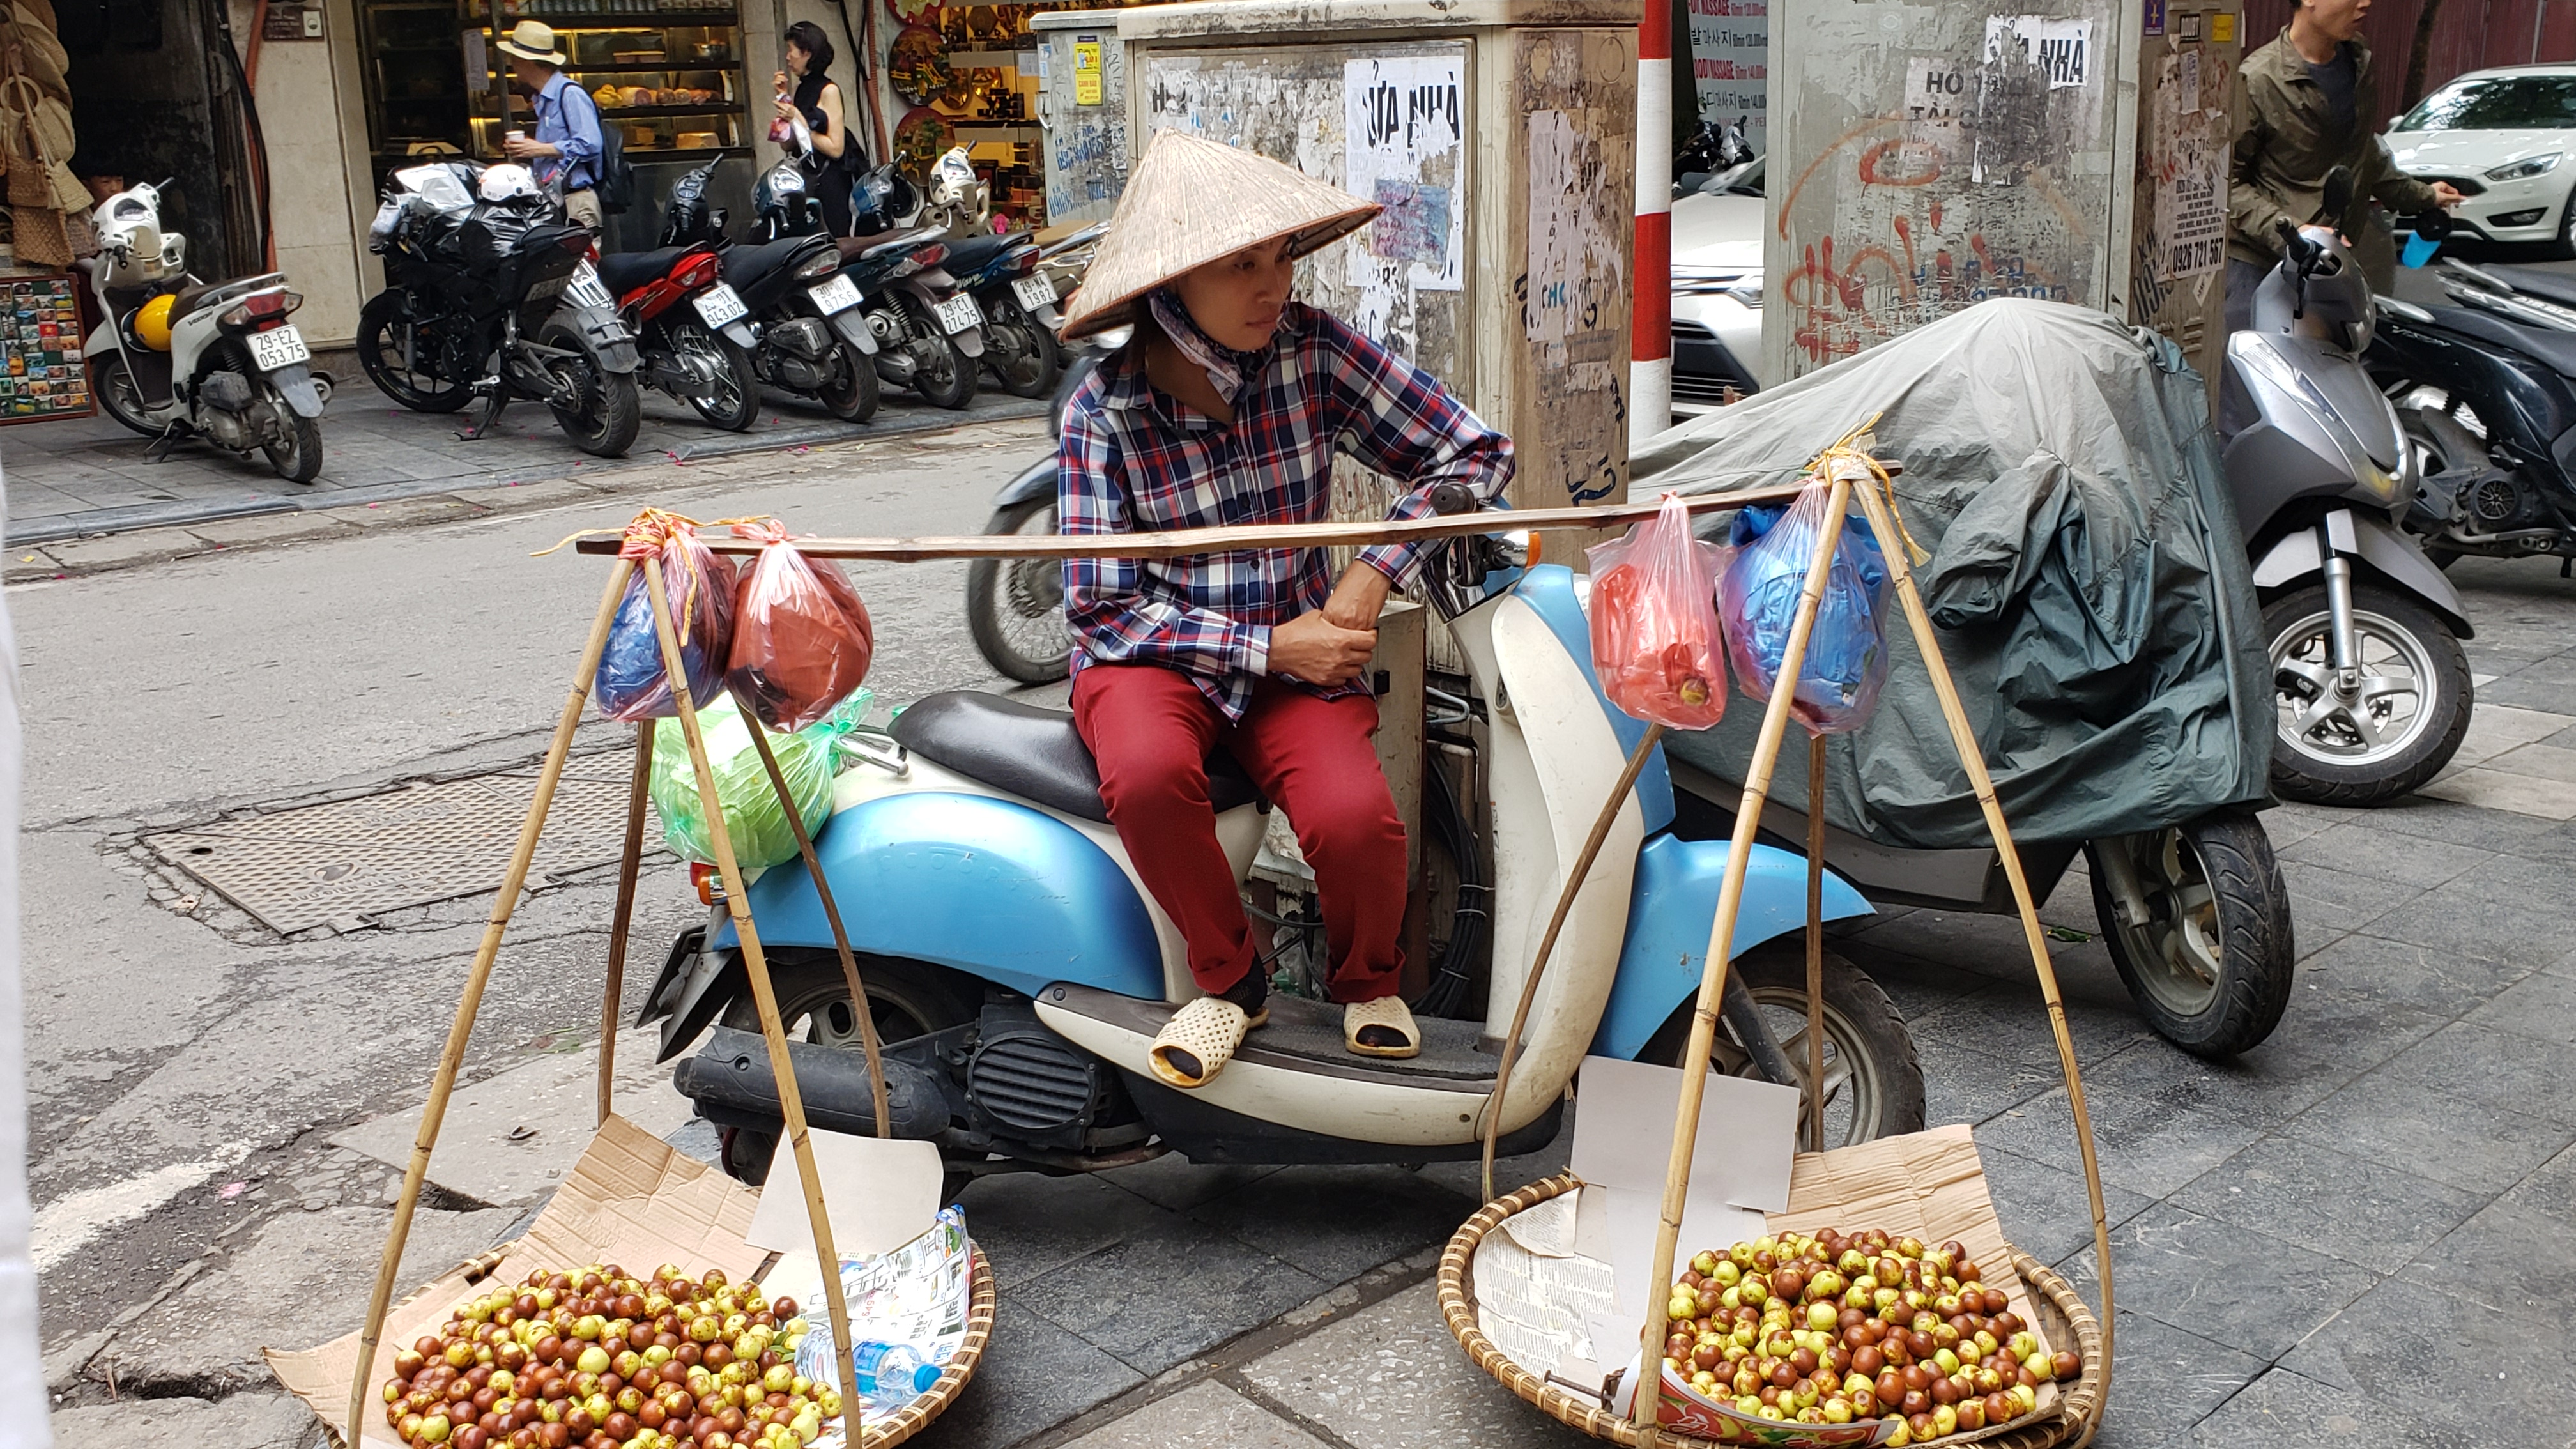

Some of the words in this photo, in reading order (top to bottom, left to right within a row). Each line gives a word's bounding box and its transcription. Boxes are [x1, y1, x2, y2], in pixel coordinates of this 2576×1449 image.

[2173, 242, 2193, 273] 0926
[2194, 240, 2207, 270] 721
[2209, 236, 2224, 266] 567
[824, 291, 856, 311] 9756
[941, 298, 969, 318] 29-C1
[1027, 288, 1053, 307] 1982
[707, 301, 744, 326] 943.02
[945, 309, 978, 333] 274.75
[256, 328, 296, 351] 29-E2
[259, 343, 306, 368] 053.75
